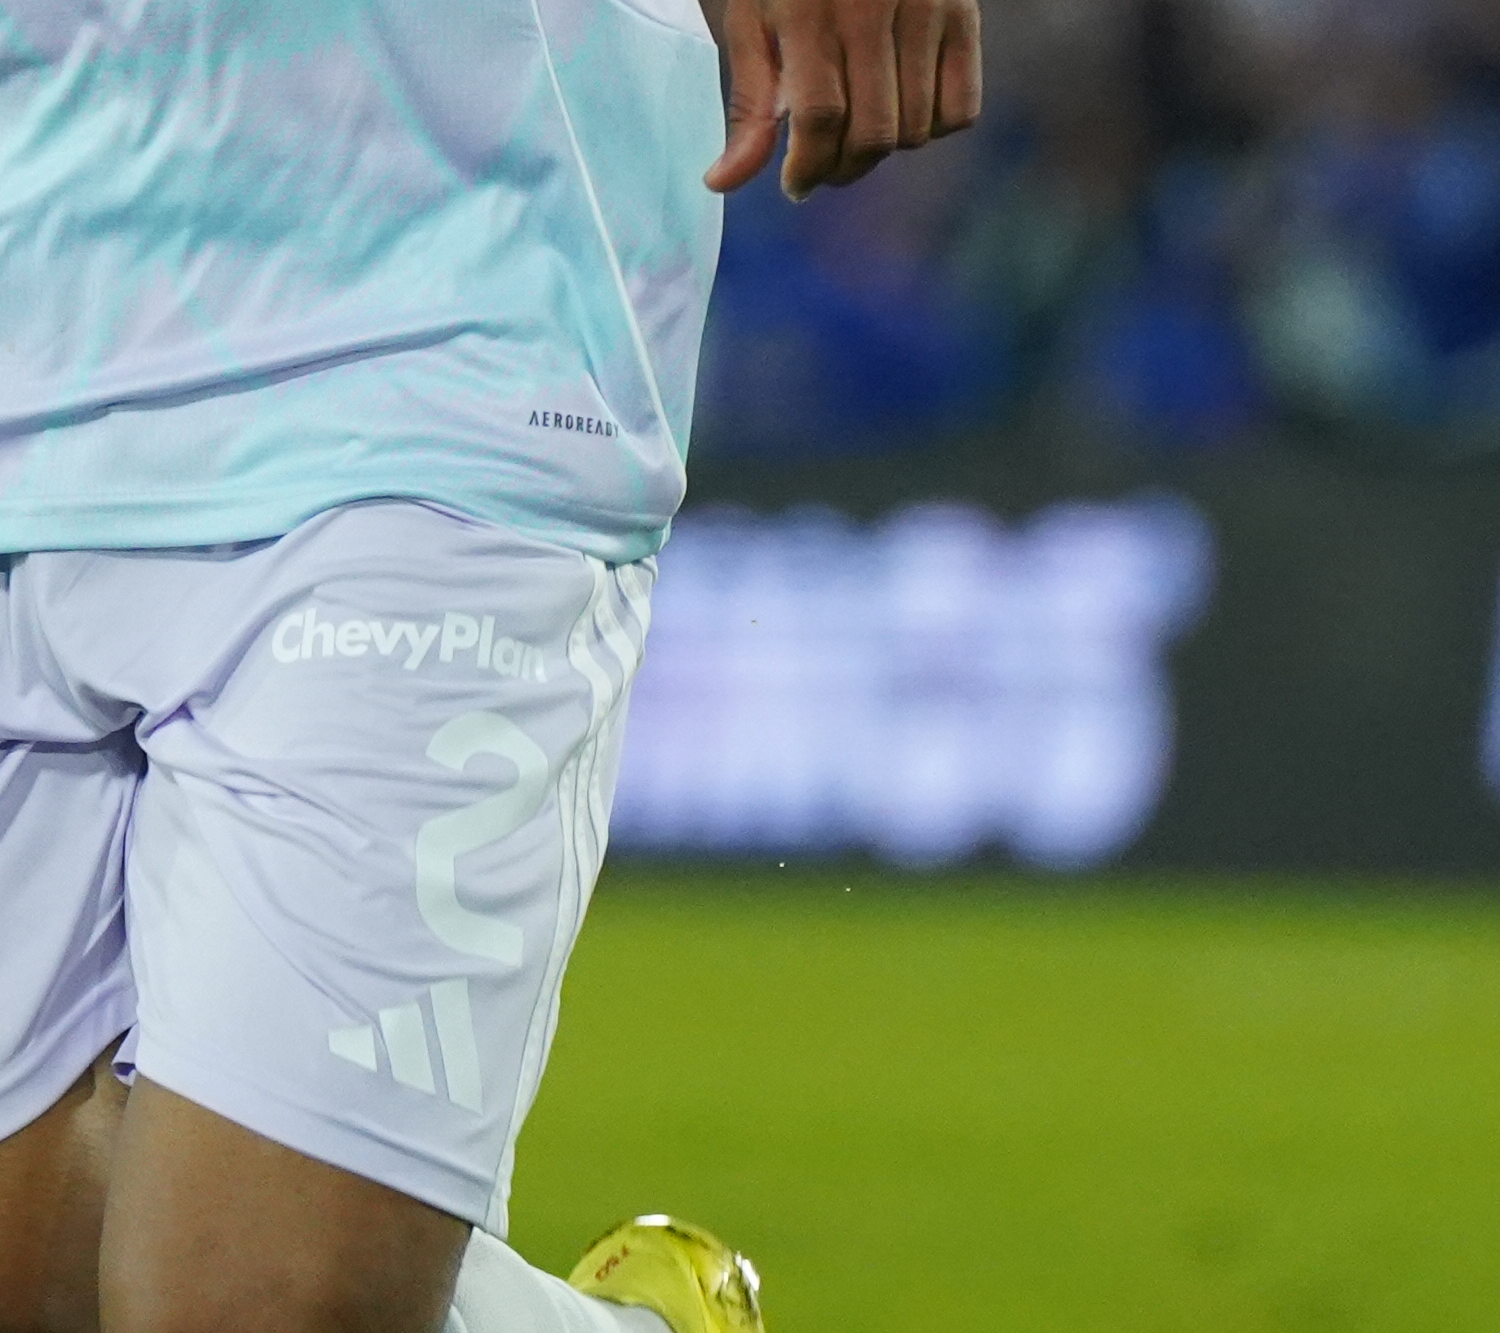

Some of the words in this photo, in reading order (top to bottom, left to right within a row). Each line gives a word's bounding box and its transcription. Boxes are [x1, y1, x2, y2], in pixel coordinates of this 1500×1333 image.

[529, 410, 619, 438] AEROREADY
[271, 607, 548, 683] ChevyPlan
[415, 709, 549, 969] 2
